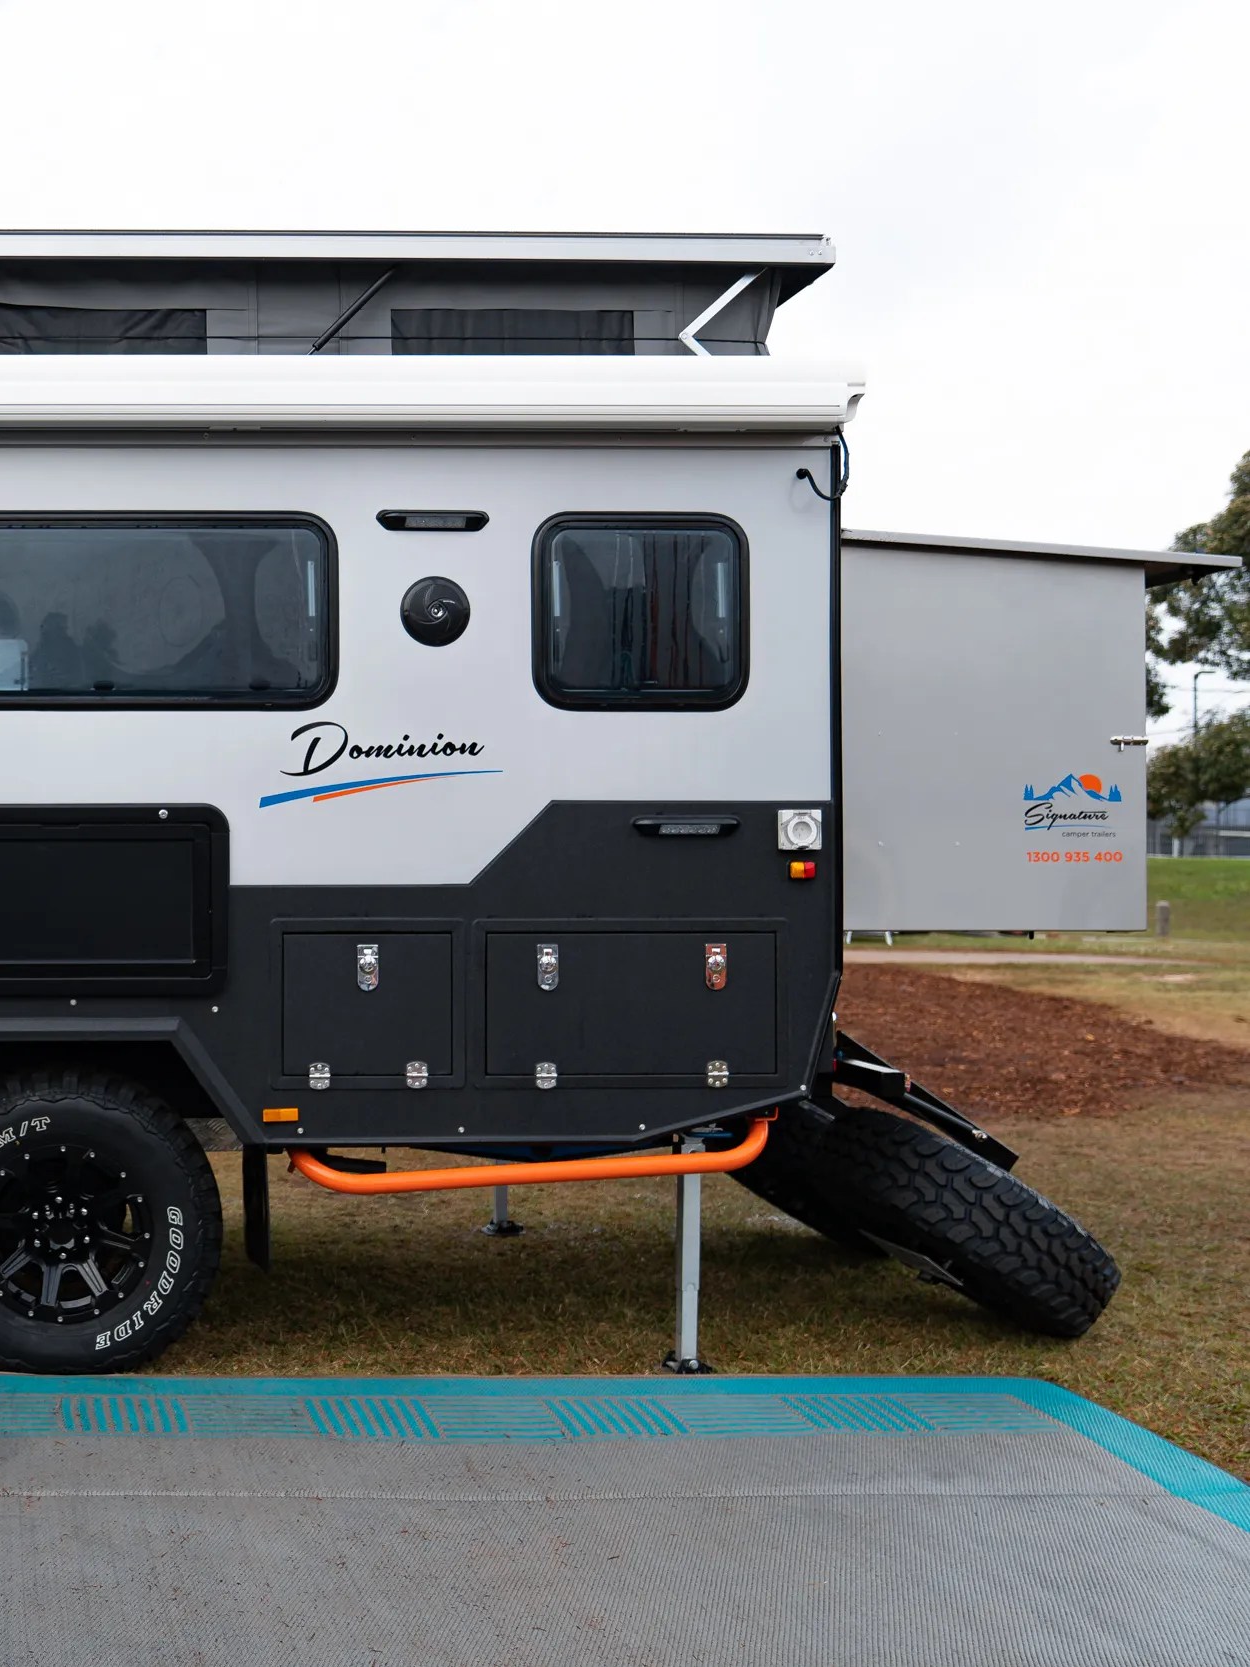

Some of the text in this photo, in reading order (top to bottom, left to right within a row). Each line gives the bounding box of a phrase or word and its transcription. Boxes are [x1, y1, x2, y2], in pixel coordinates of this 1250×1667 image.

[280, 721, 485, 777] Dominion
[1024, 802, 1109, 830] Signature
[1027, 851, 1123, 862] 1300 935 400
[95, 1206, 184, 1351] GOODRIDE
